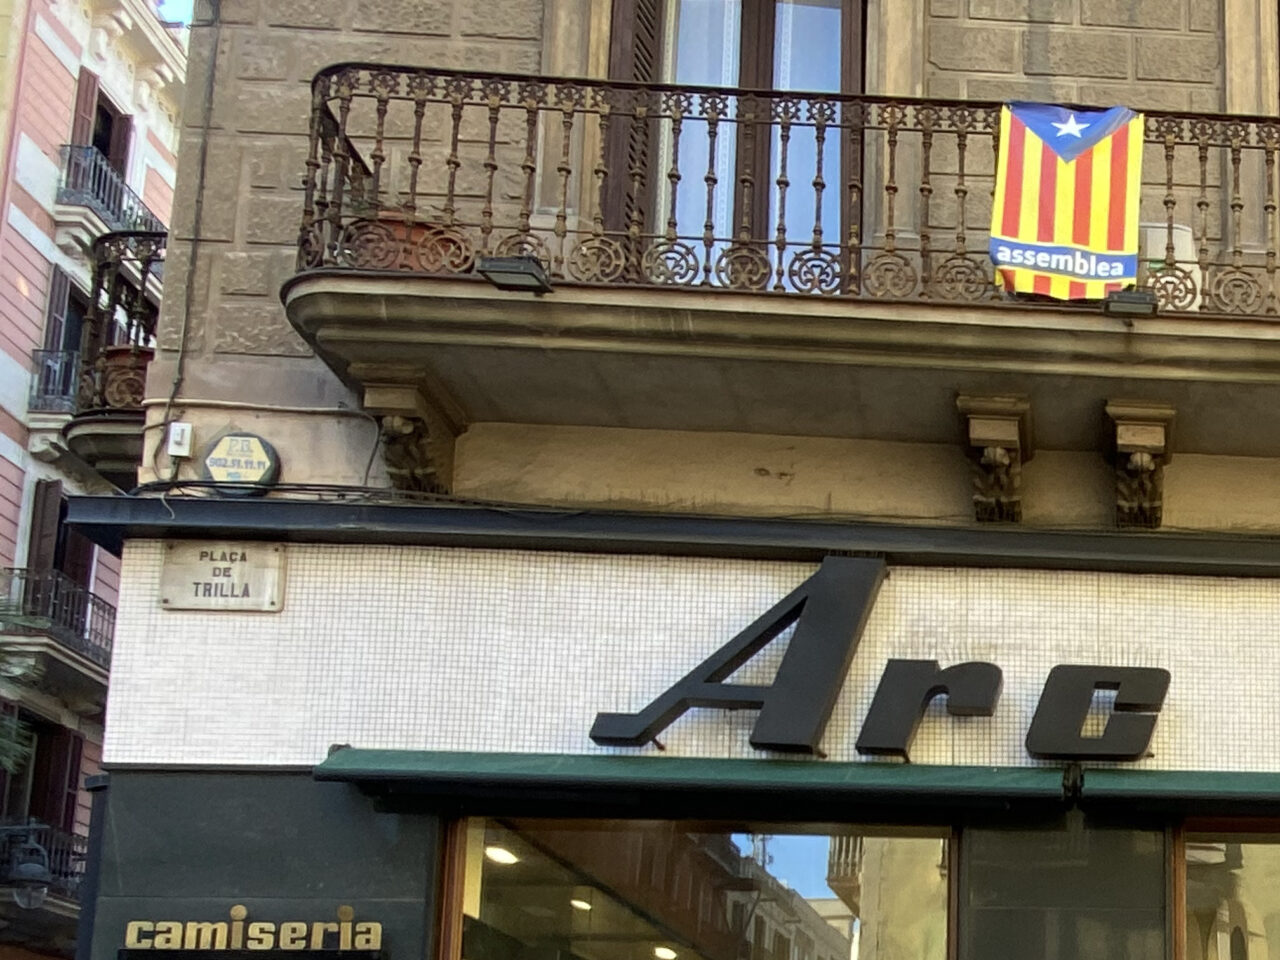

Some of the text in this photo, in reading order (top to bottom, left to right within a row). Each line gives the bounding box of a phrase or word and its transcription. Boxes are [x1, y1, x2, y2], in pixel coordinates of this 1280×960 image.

[997, 245, 1124, 277] assemblea
[200, 551, 247, 563] PLAÇA
[212, 567, 232, 577] DE
[193, 582, 250, 598] TRILLA
[588, 556, 1171, 761] Arc
[124, 904, 382, 951] camiseria
